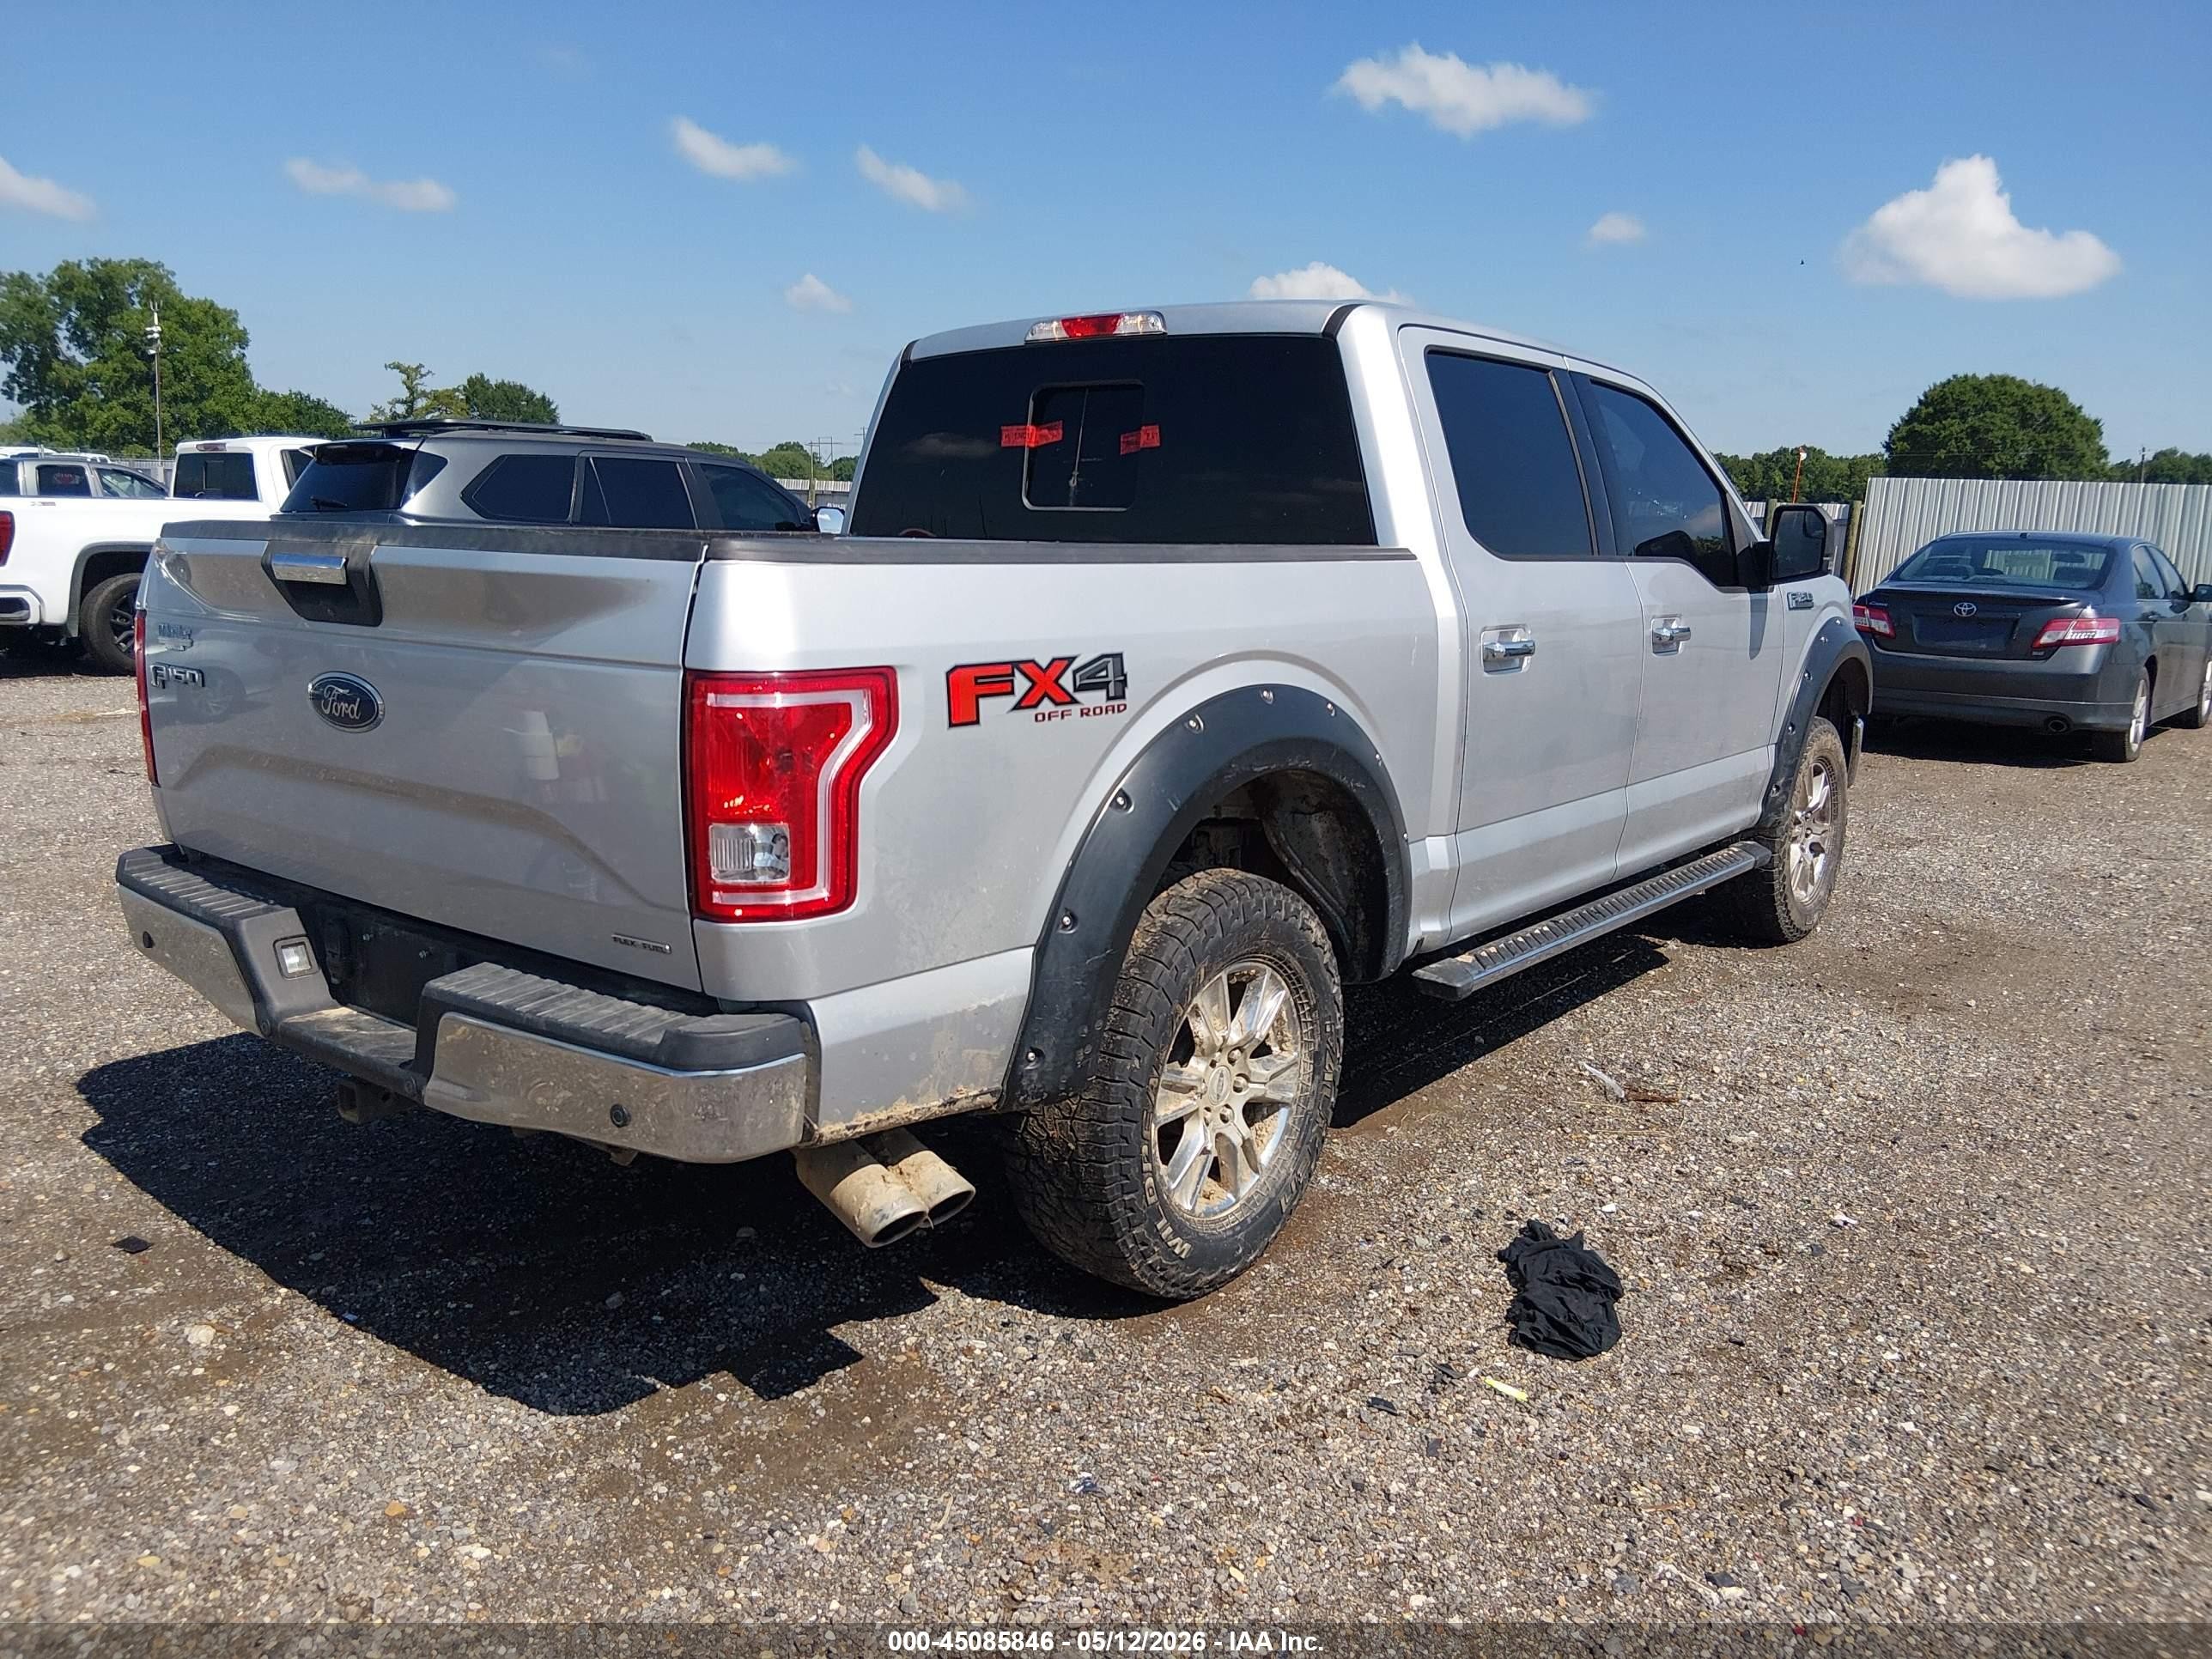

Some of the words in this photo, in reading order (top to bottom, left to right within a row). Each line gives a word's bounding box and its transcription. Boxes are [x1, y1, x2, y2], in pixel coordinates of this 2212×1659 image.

[322, 684, 362, 720] Ford
[945, 652, 1127, 728] FX4
[1034, 708, 1072, 723] OFF
[1079, 702, 1127, 718] ROAD
